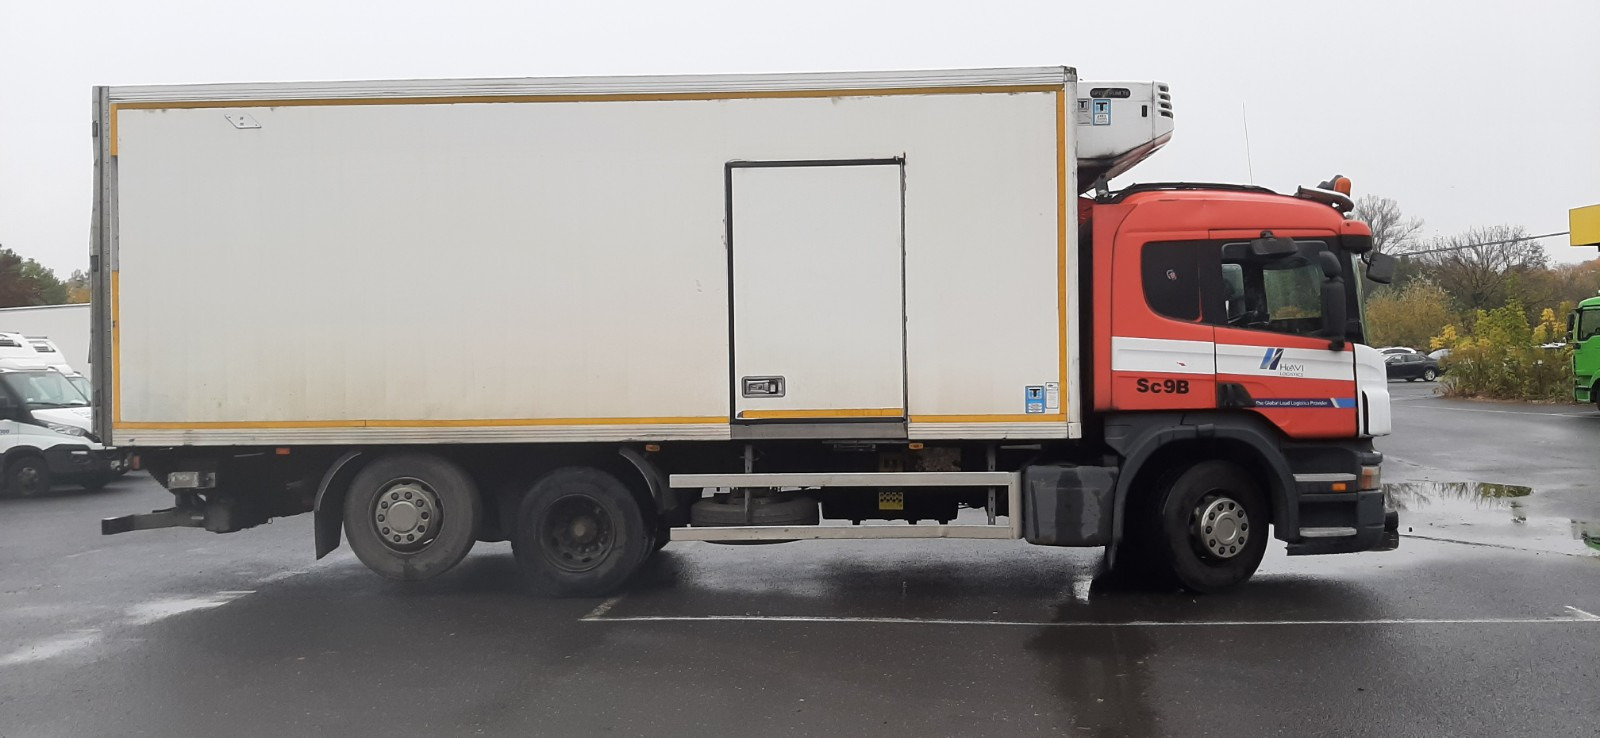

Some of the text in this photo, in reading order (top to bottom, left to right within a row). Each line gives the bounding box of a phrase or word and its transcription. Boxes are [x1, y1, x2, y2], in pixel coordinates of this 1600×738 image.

[1095, 102, 1108, 111] T
[1136, 377, 1190, 395] Sc9B
[1028, 388, 1041, 398] T
